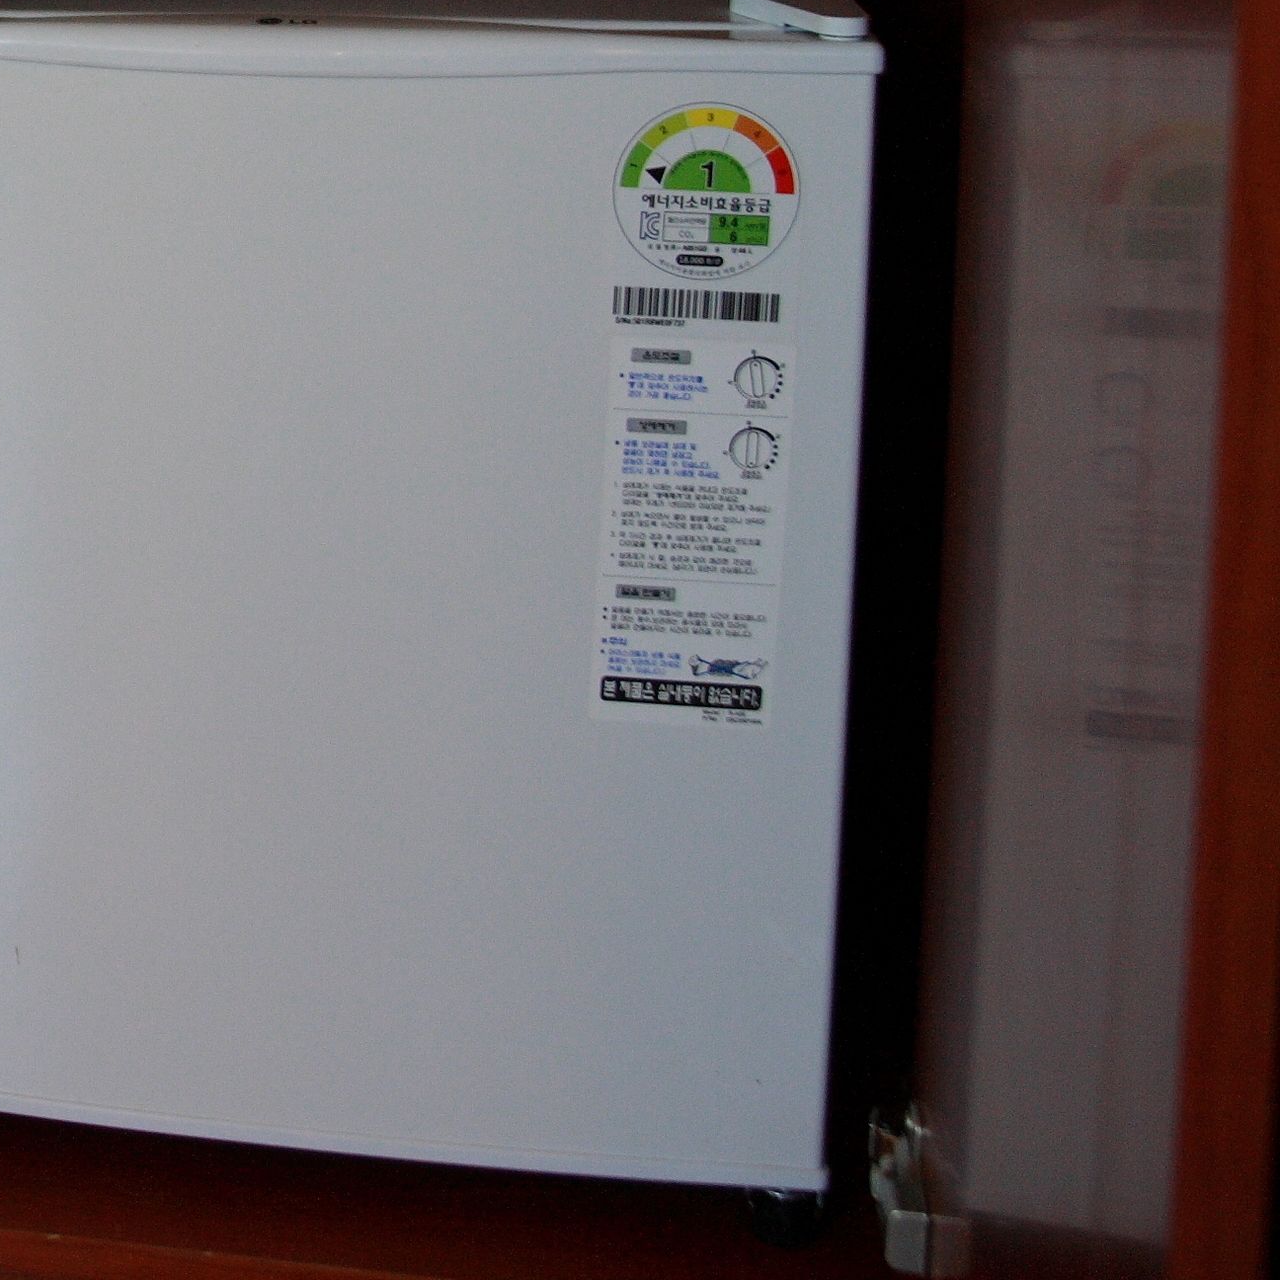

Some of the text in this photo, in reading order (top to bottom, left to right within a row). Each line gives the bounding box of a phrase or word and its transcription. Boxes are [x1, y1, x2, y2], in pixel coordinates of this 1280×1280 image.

[706, 112, 715, 122] 3
[659, 125, 667, 135] 2
[700, 160, 715, 189] 1
[641, 193, 771, 213] 에너지소비효율등급
